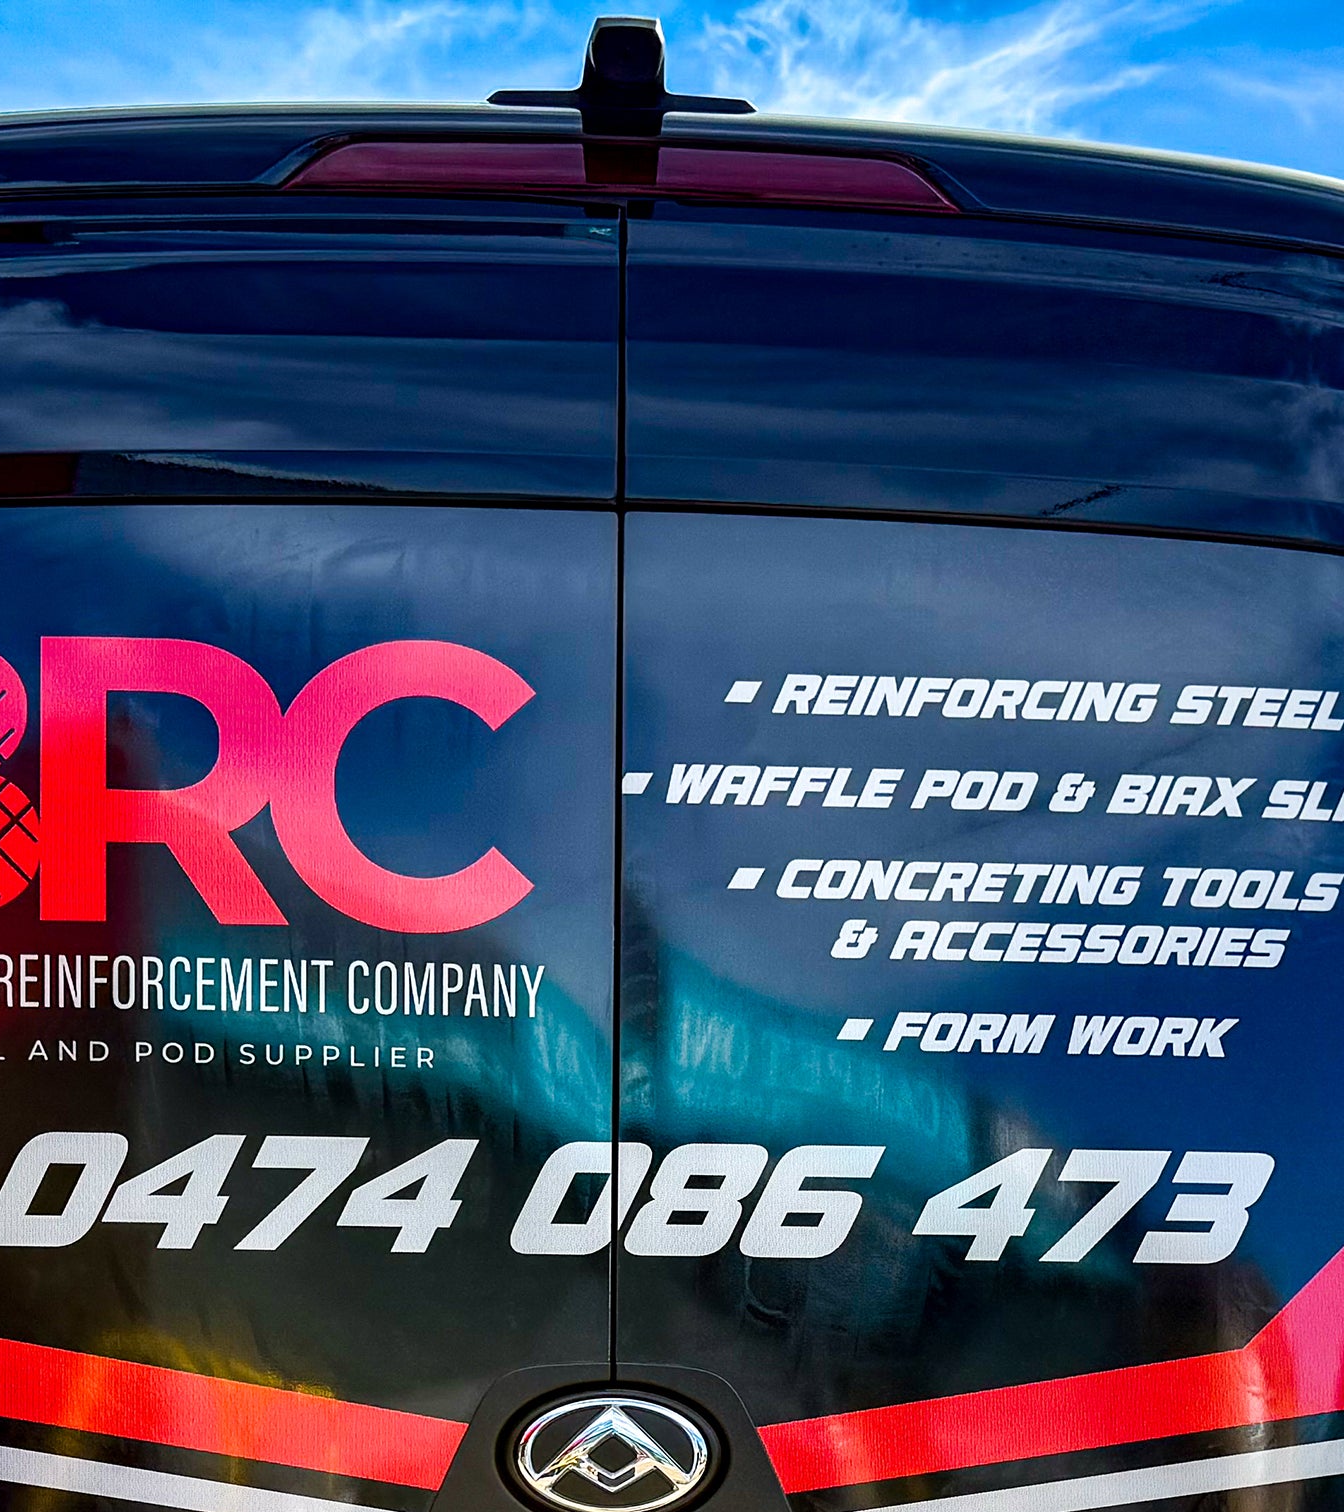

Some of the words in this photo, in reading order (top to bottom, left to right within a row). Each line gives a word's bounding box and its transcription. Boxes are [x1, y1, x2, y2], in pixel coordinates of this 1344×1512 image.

[771, 673, 1158, 723] REINFORCING
[1168, 685, 1344, 731] STEEL
[664, 763, 905, 809] WAFFLE
[909, 769, 1040, 812] POD
[1049, 773, 1096, 813] &
[1105, 775, 1261, 818] BIAX
[775, 859, 1144, 906] CONCRETING
[830, 919, 878, 960] &
[890, 920, 1292, 968] ACCESSORIES
[347, 960, 545, 1018] COMPANY
[28, 1039, 110, 1063] AND
[135, 1040, 216, 1064] POD
[239, 1042, 436, 1069] SUPPLIER
[882, 1011, 1055, 1054] FORM
[1065, 1015, 1240, 1059] WORK
[509, 1140, 886, 1260] 086
[912, 1148, 1276, 1265] 473
